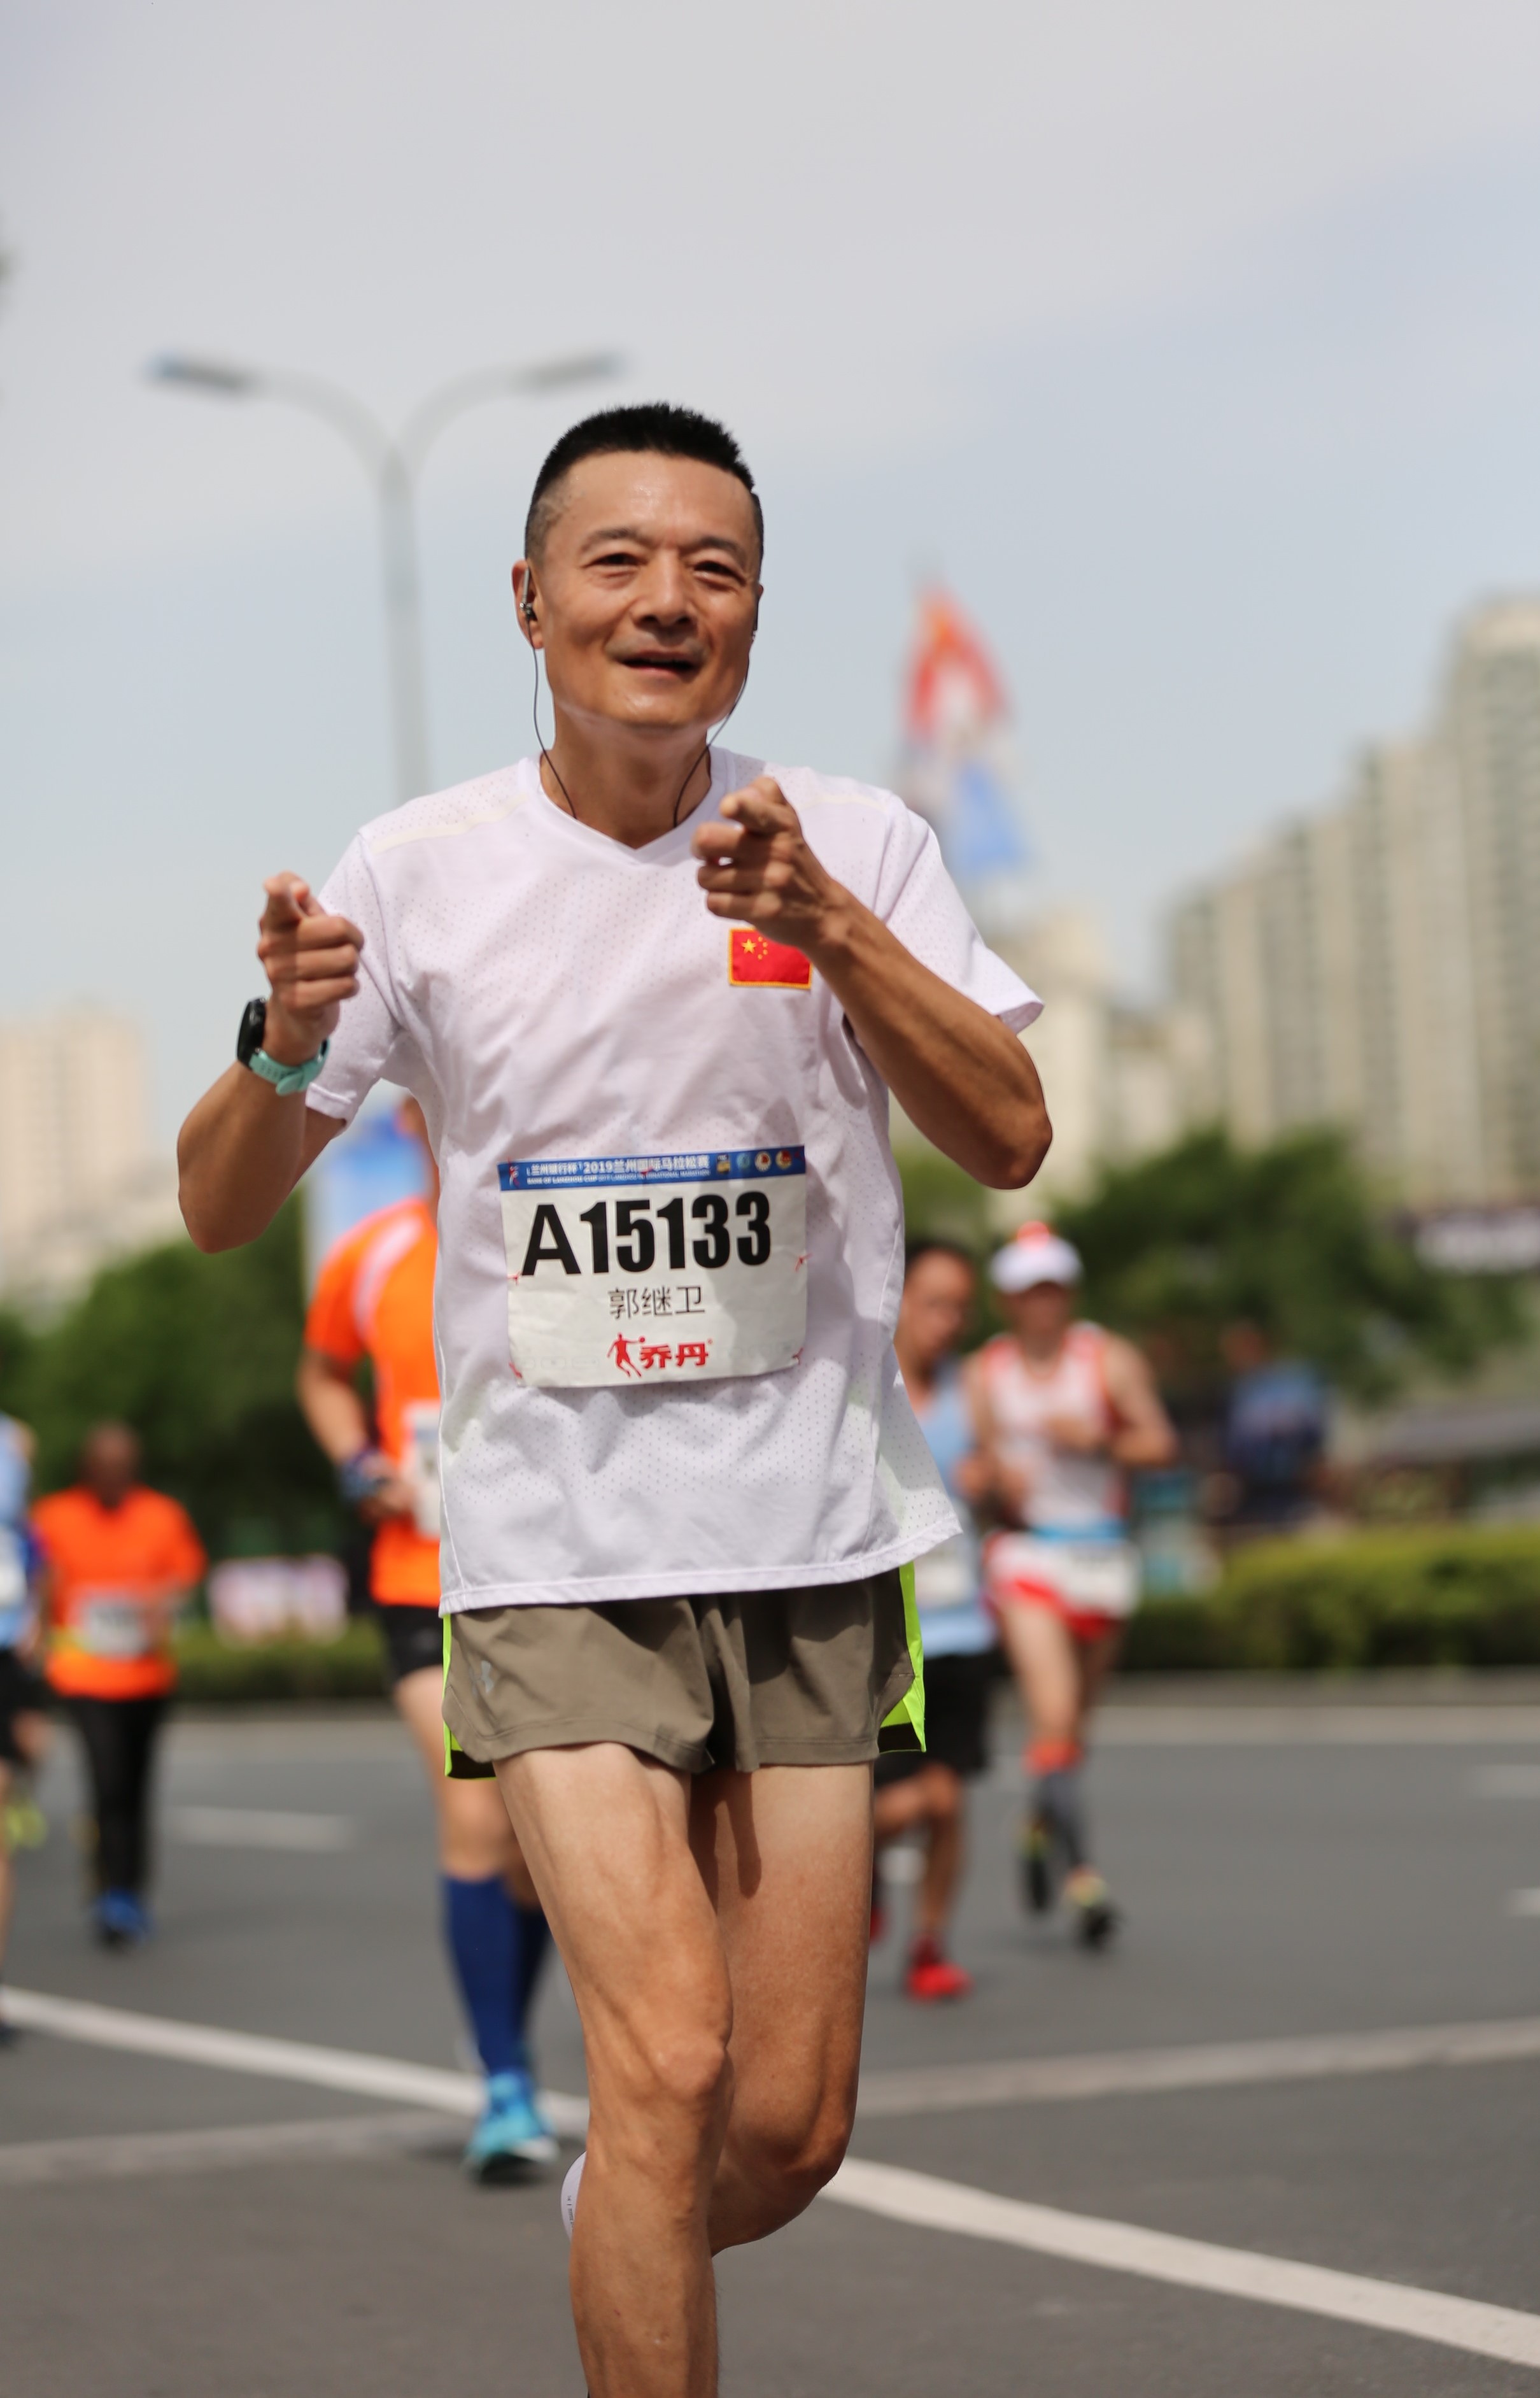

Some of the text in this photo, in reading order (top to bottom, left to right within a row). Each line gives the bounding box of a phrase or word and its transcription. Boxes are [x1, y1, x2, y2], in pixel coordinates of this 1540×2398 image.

[521, 1191, 771, 1276] A15133
[608, 1285, 705, 1319] 郭继卫
[640, 1343, 709, 1369] 乔丹
